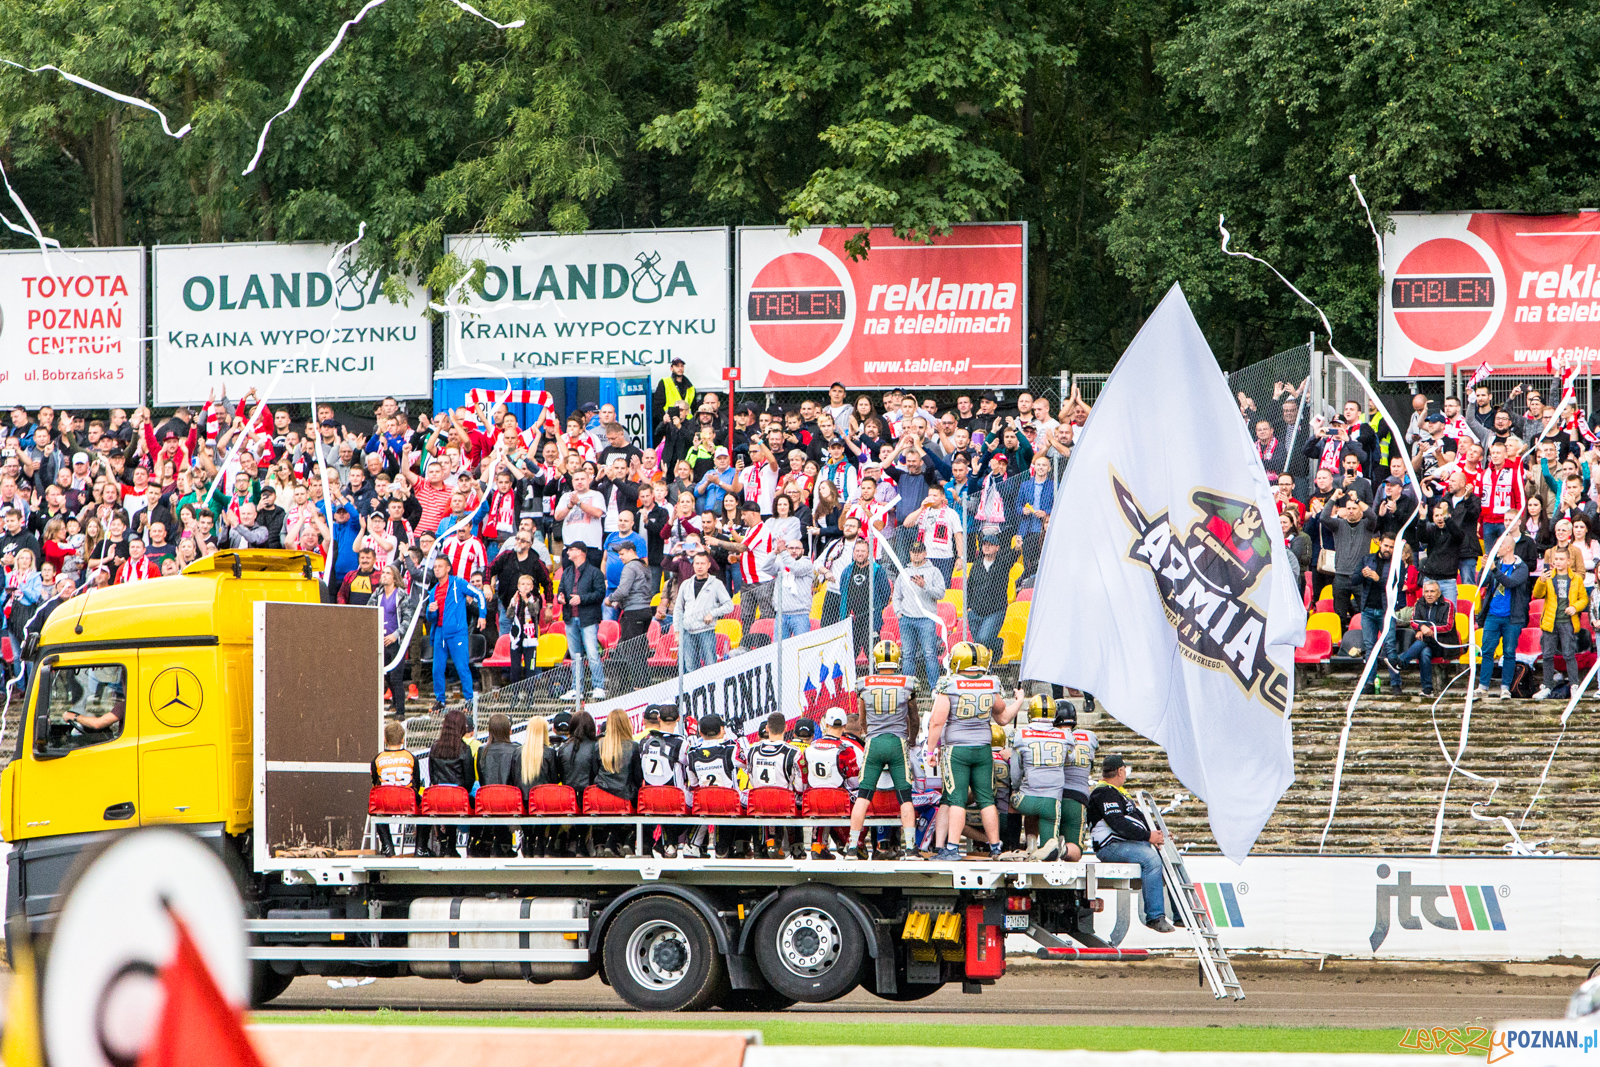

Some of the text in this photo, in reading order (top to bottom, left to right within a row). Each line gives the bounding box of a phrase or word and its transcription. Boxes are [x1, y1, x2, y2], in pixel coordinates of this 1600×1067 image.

[22, 275, 128, 298] TOYOTA
[867, 277, 1017, 312] reklama
[1395, 280, 1490, 303] TABLEN
[752, 293, 841, 316] TABLEN
[1514, 306, 1542, 323] na
[28, 301, 121, 330] POZNAŃ
[863, 313, 1011, 335] na telebimach
[460, 318, 716, 339] KRAINA WYPOCZYNKU
[28, 336, 121, 355] CENTRUM
[168, 330, 253, 348] KRAINA
[24, 369, 39, 381] ul.
[42, 367, 113, 381] Bobrzańska
[116, 368, 124, 380] 5
[864, 358, 970, 374] www.tablen.pl
[871, 687, 898, 715] 11
[956, 693, 993, 720] 69
[1028, 741, 1063, 767] 13
[650, 758, 658, 774] 7
[760, 768, 770, 783] 4
[815, 762, 826, 777] 6
[381, 767, 412, 786] 55
[706, 774, 718, 786] 2
